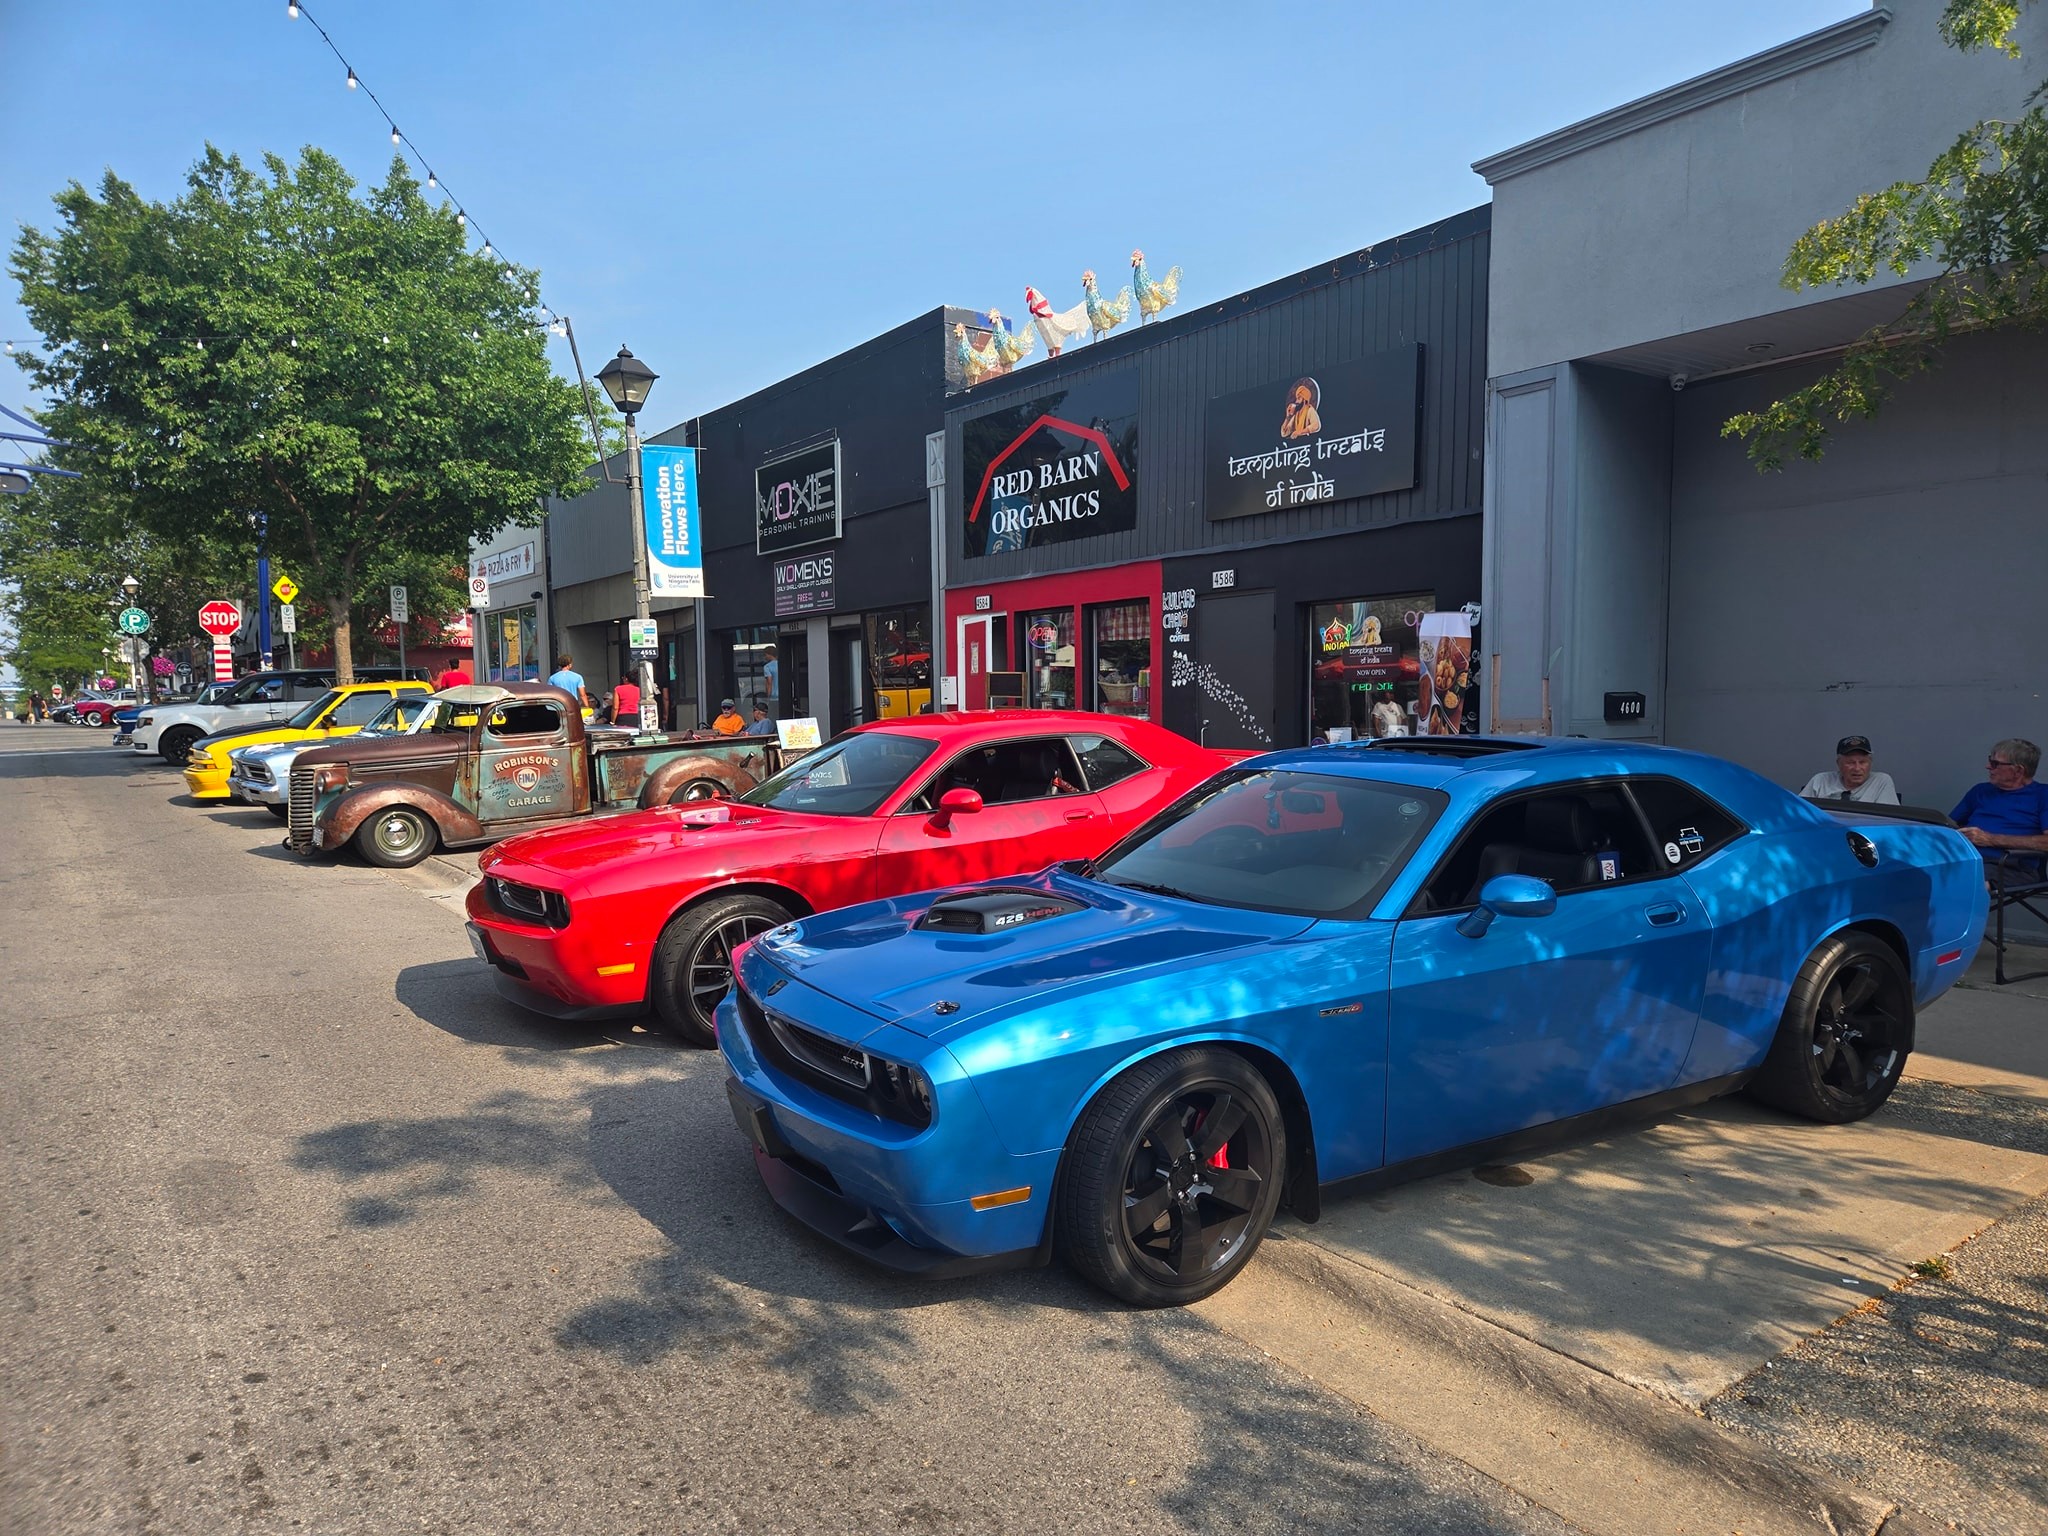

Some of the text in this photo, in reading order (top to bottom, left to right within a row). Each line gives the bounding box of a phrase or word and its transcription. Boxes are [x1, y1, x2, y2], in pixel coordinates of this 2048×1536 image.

[1228, 428, 1386, 479] tempting treats
[992, 451, 1100, 500] RED BARN
[758, 468, 835, 526] MOXIE
[1266, 471, 1335, 507] of india
[656, 466, 675, 555] Innovation
[671, 459, 690, 555] Flows Here.
[991, 490, 1100, 534] ORGANICS
[759, 510, 835, 537] PERSONAL TRAINING
[488, 560, 504, 577] PIZZA
[510, 554, 522, 570] FRY
[776, 557, 833, 585] WOMEN'S
[1214, 572, 1234, 586] 4586
[202, 612, 238, 626] STOP
[1029, 627, 1056, 641] OPEN
[1323, 641, 1350, 652] INDIAN
[1356, 668, 1387, 676] NOW OPEN
[1620, 701, 1640, 714] 4600
[494, 756, 560, 773] ROBINSON'S
[518, 773, 536, 784] FINA
[508, 795, 552, 808] GARAGE
[1026, 906, 1062, 918] HEMI
